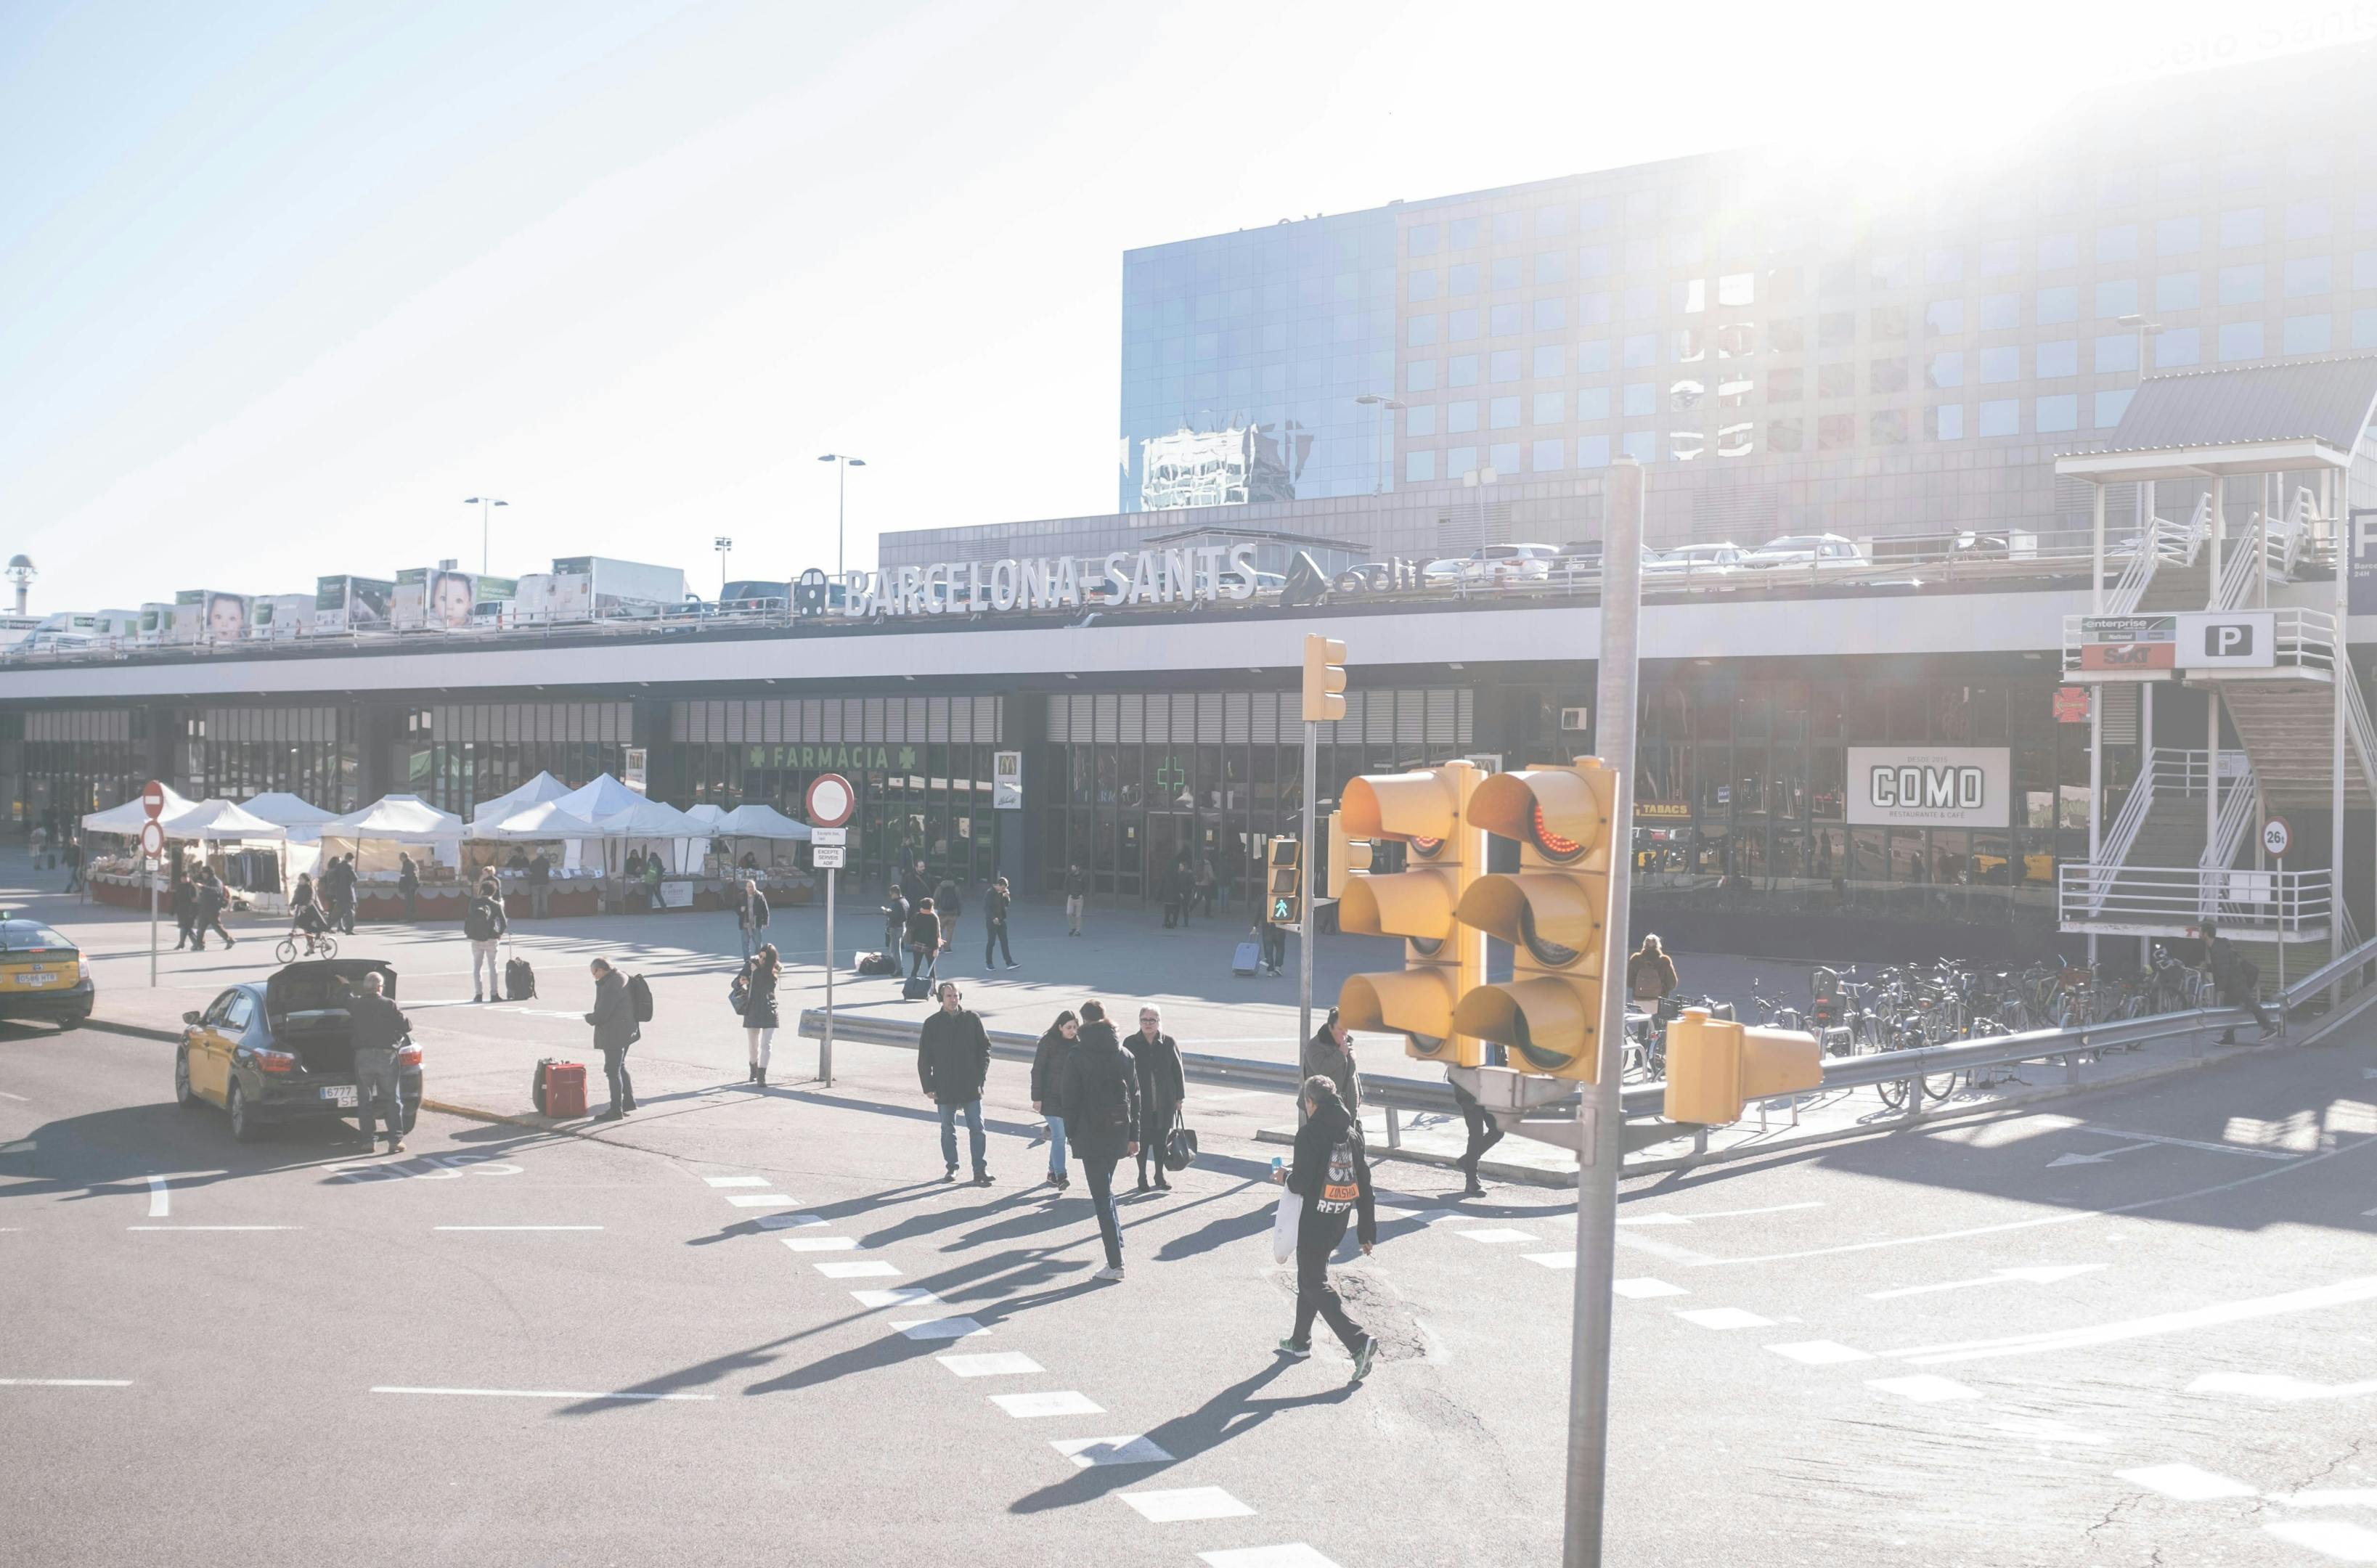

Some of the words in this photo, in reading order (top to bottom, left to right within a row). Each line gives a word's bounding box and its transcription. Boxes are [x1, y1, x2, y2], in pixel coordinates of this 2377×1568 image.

[845, 542, 1259, 617] BARCELONA-SANTS
[1333, 556, 1438, 593] adif
[2087, 618, 2147, 629] enterprise
[2218, 626, 2242, 656] P
[774, 741, 889, 769] FARMÀCIA
[1870, 765, 1983, 809] COMO
[1643, 804, 1687, 814] TABACS
[327, 1087, 351, 1097] 6777
